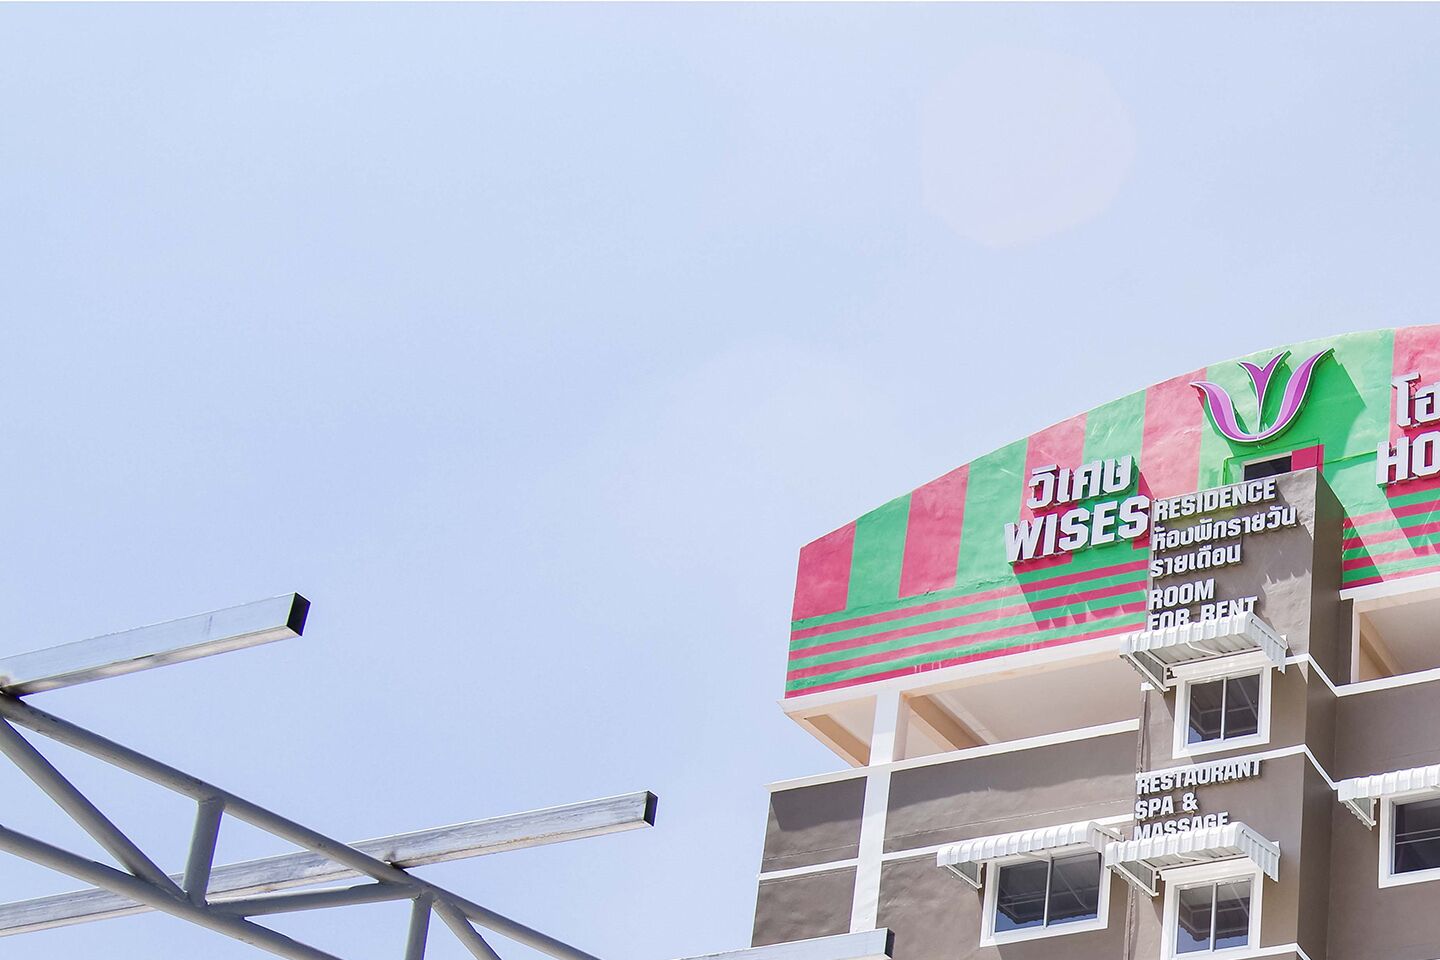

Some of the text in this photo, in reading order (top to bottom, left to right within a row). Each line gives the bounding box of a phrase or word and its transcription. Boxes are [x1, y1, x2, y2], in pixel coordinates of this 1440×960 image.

[1153, 479, 1277, 522] RESIDENCE
[1004, 495, 1150, 562] WISES
[1152, 505, 1298, 552] ห้องพักรายวัน
[1150, 544, 1243, 578] รายเดือน
[1148, 578, 1215, 611] ROOM
[1147, 596, 1258, 631] FOR RENT
[1136, 759, 1263, 795] RESTAURANT
[1135, 792, 1199, 820] SPA &
[1133, 811, 1229, 841] MASSAGE
